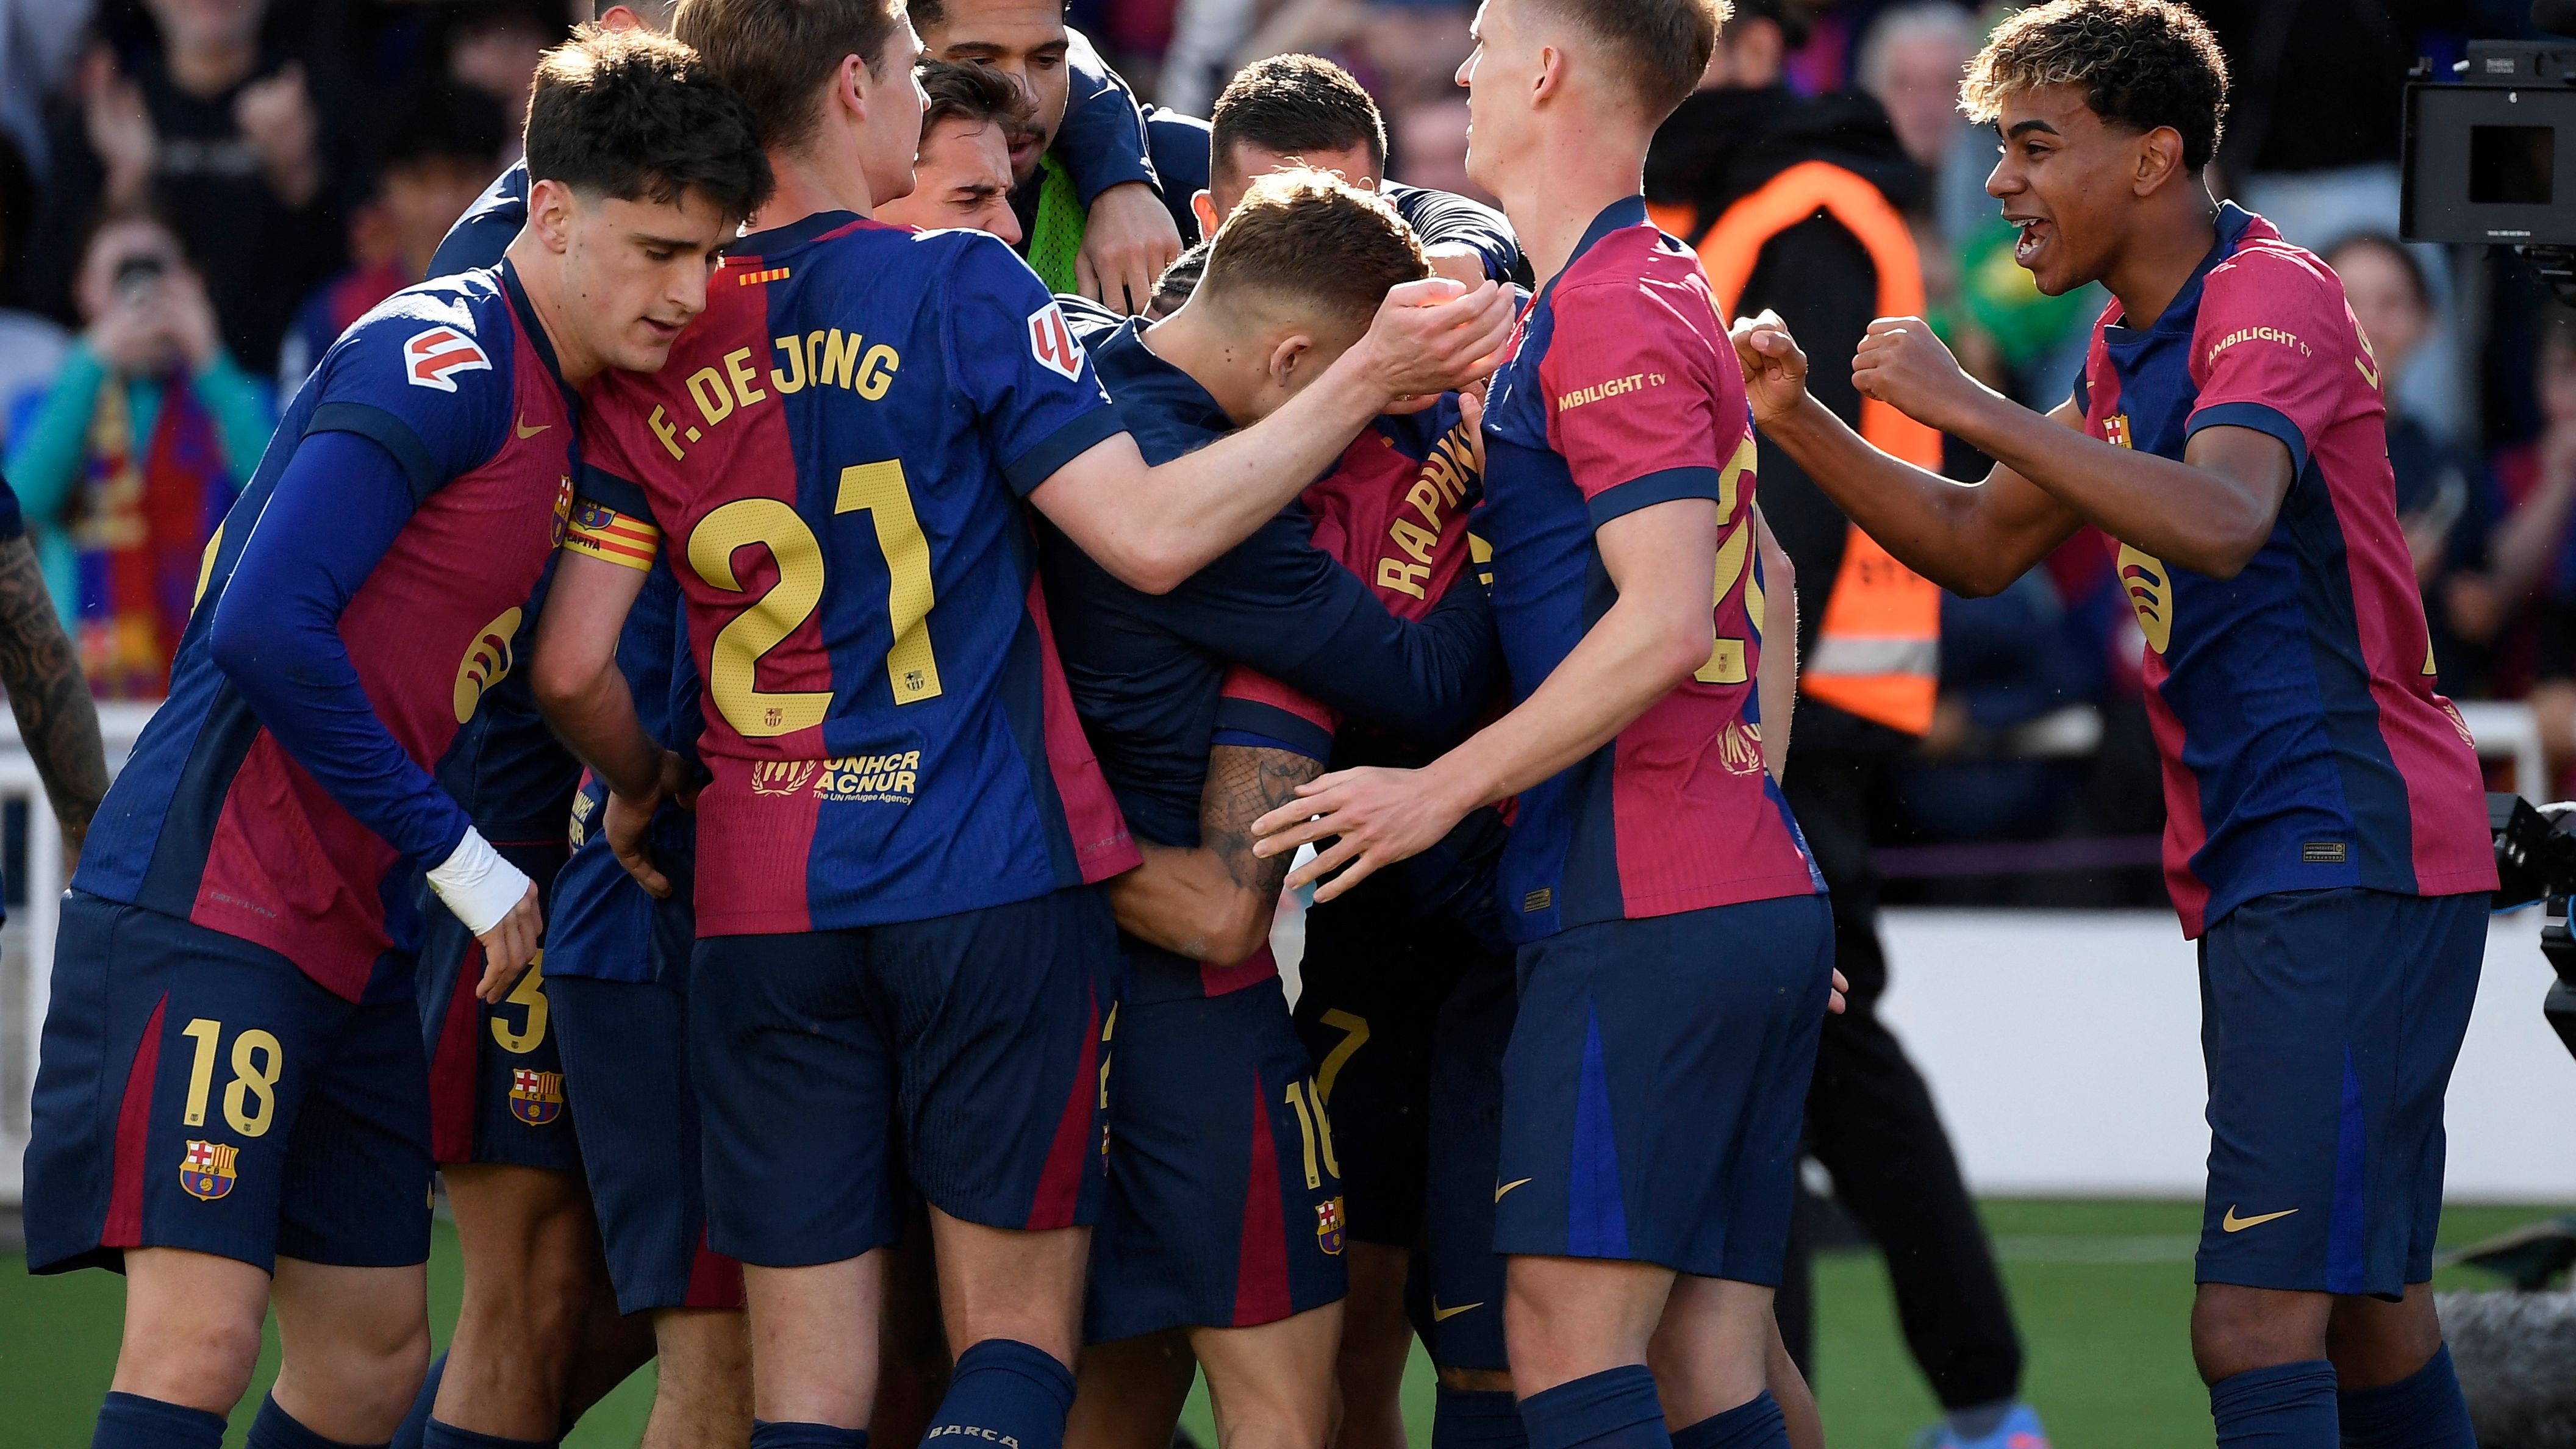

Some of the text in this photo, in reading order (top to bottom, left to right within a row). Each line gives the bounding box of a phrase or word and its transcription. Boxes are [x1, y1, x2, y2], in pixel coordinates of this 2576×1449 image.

[2208, 326, 2313, 366] AMBILIGHT tv
[648, 403, 703, 462] F.
[685, 346, 767, 427] DE
[1559, 372, 1666, 412] MBILIGHT tv
[566, 532, 601, 552] CAPITÀ
[687, 458, 943, 737] 21
[812, 790, 913, 806] The UN Refugee Agency
[813, 771, 916, 794] ACNUR
[181, 1017, 283, 1138] 18
[524, 1092, 546, 1101] FCB
[198, 1165, 220, 1175] FCB
